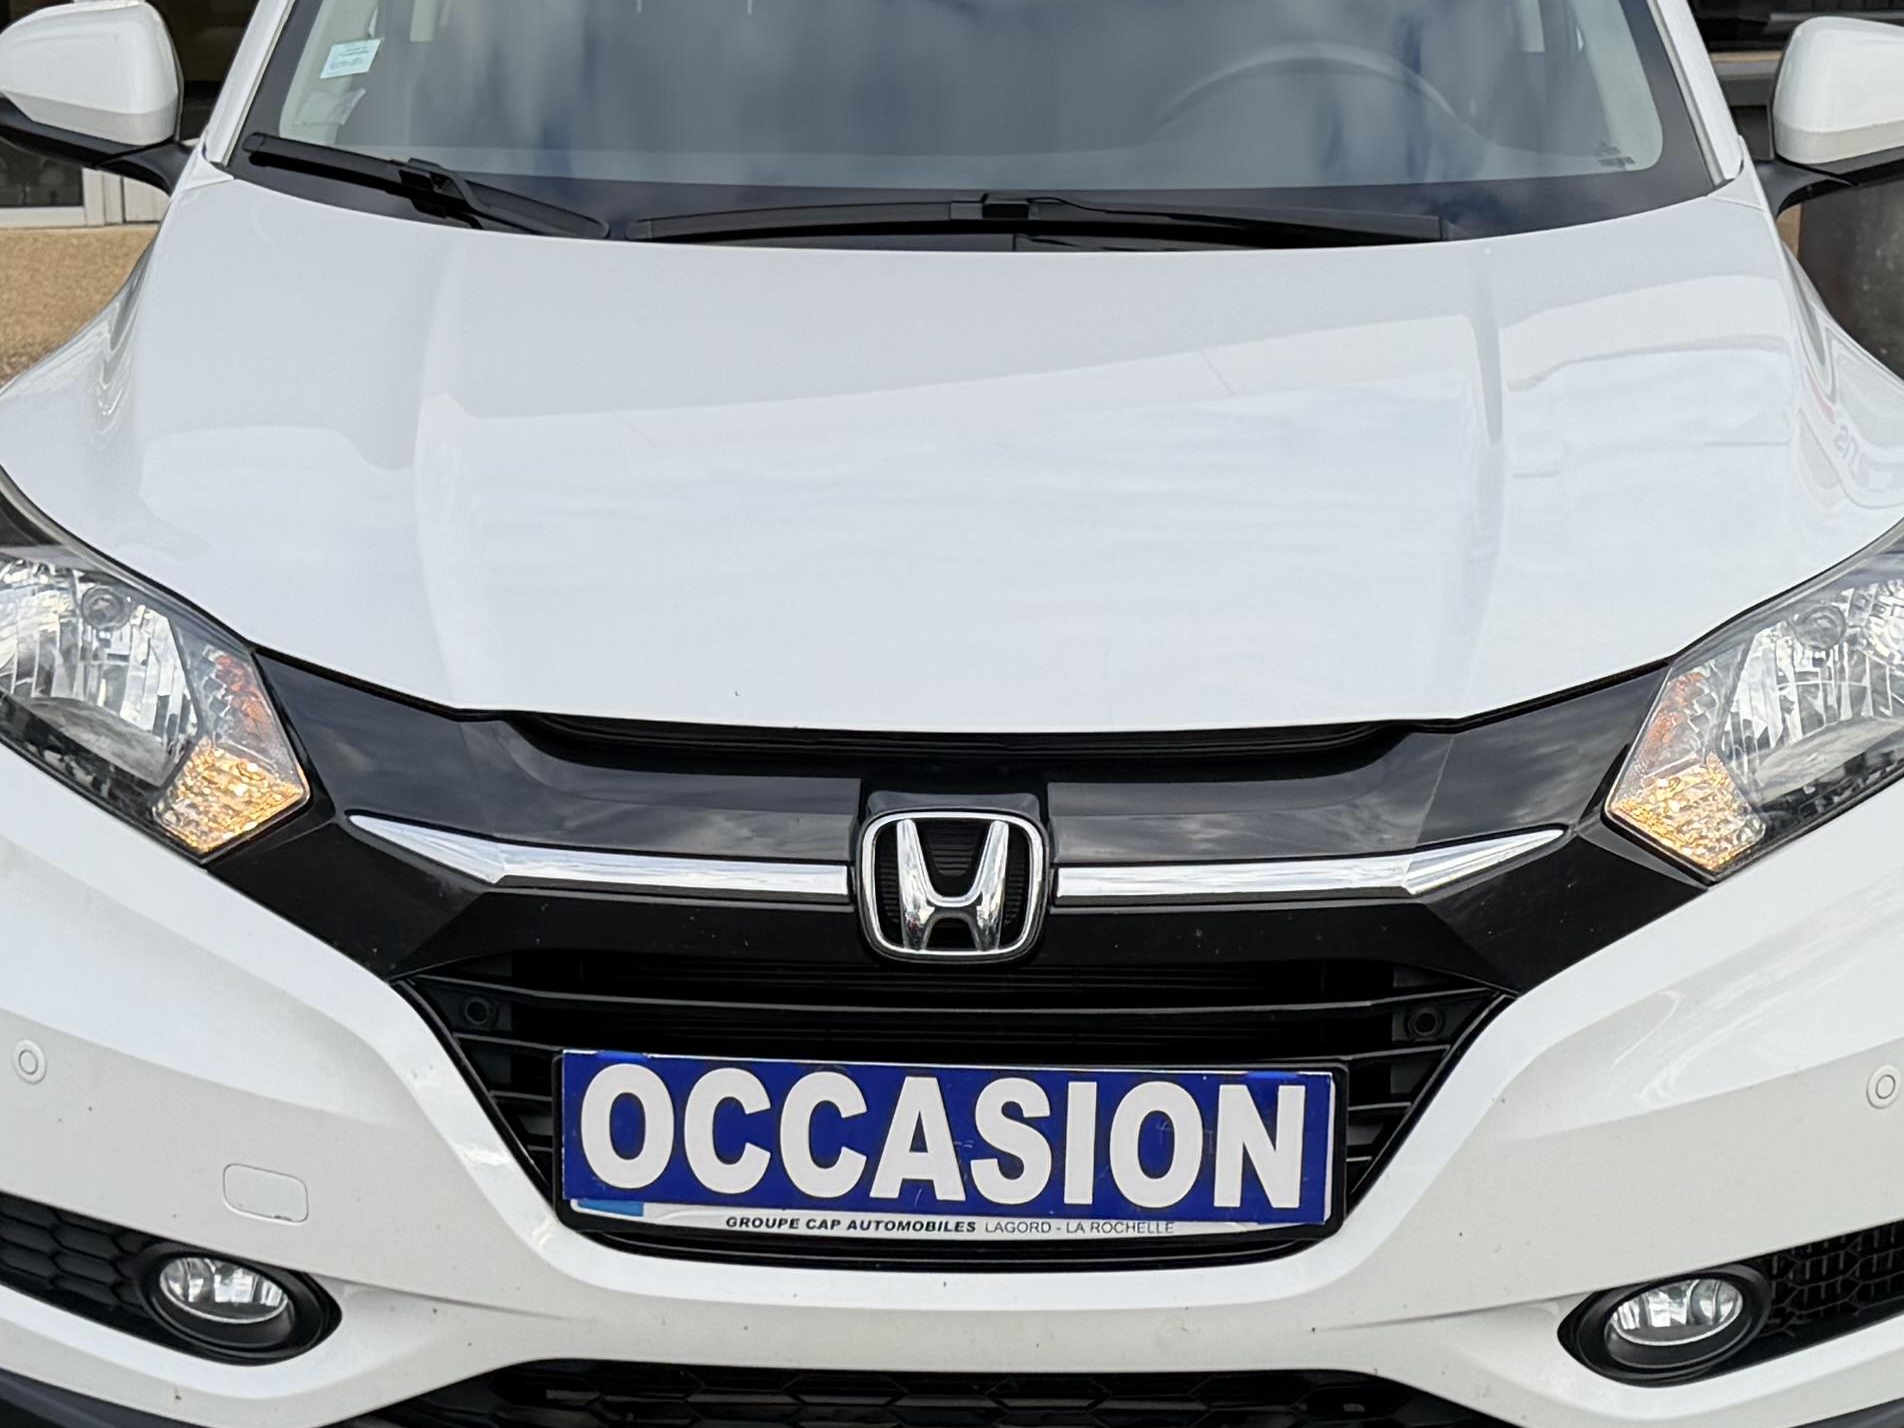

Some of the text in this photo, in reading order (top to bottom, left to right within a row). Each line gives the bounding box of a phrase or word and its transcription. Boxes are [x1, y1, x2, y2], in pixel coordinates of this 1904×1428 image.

[578, 1062, 1306, 1210] OCCASION
[725, 1216, 800, 1230] GROUPE
[805, 1217, 841, 1231] CAP
[846, 1219, 977, 1234] AUTOMOBILES
[984, 1221, 1052, 1234] LAGORD
[1066, 1221, 1083, 1234] LA
[1090, 1221, 1175, 1234] ROCHELLE
